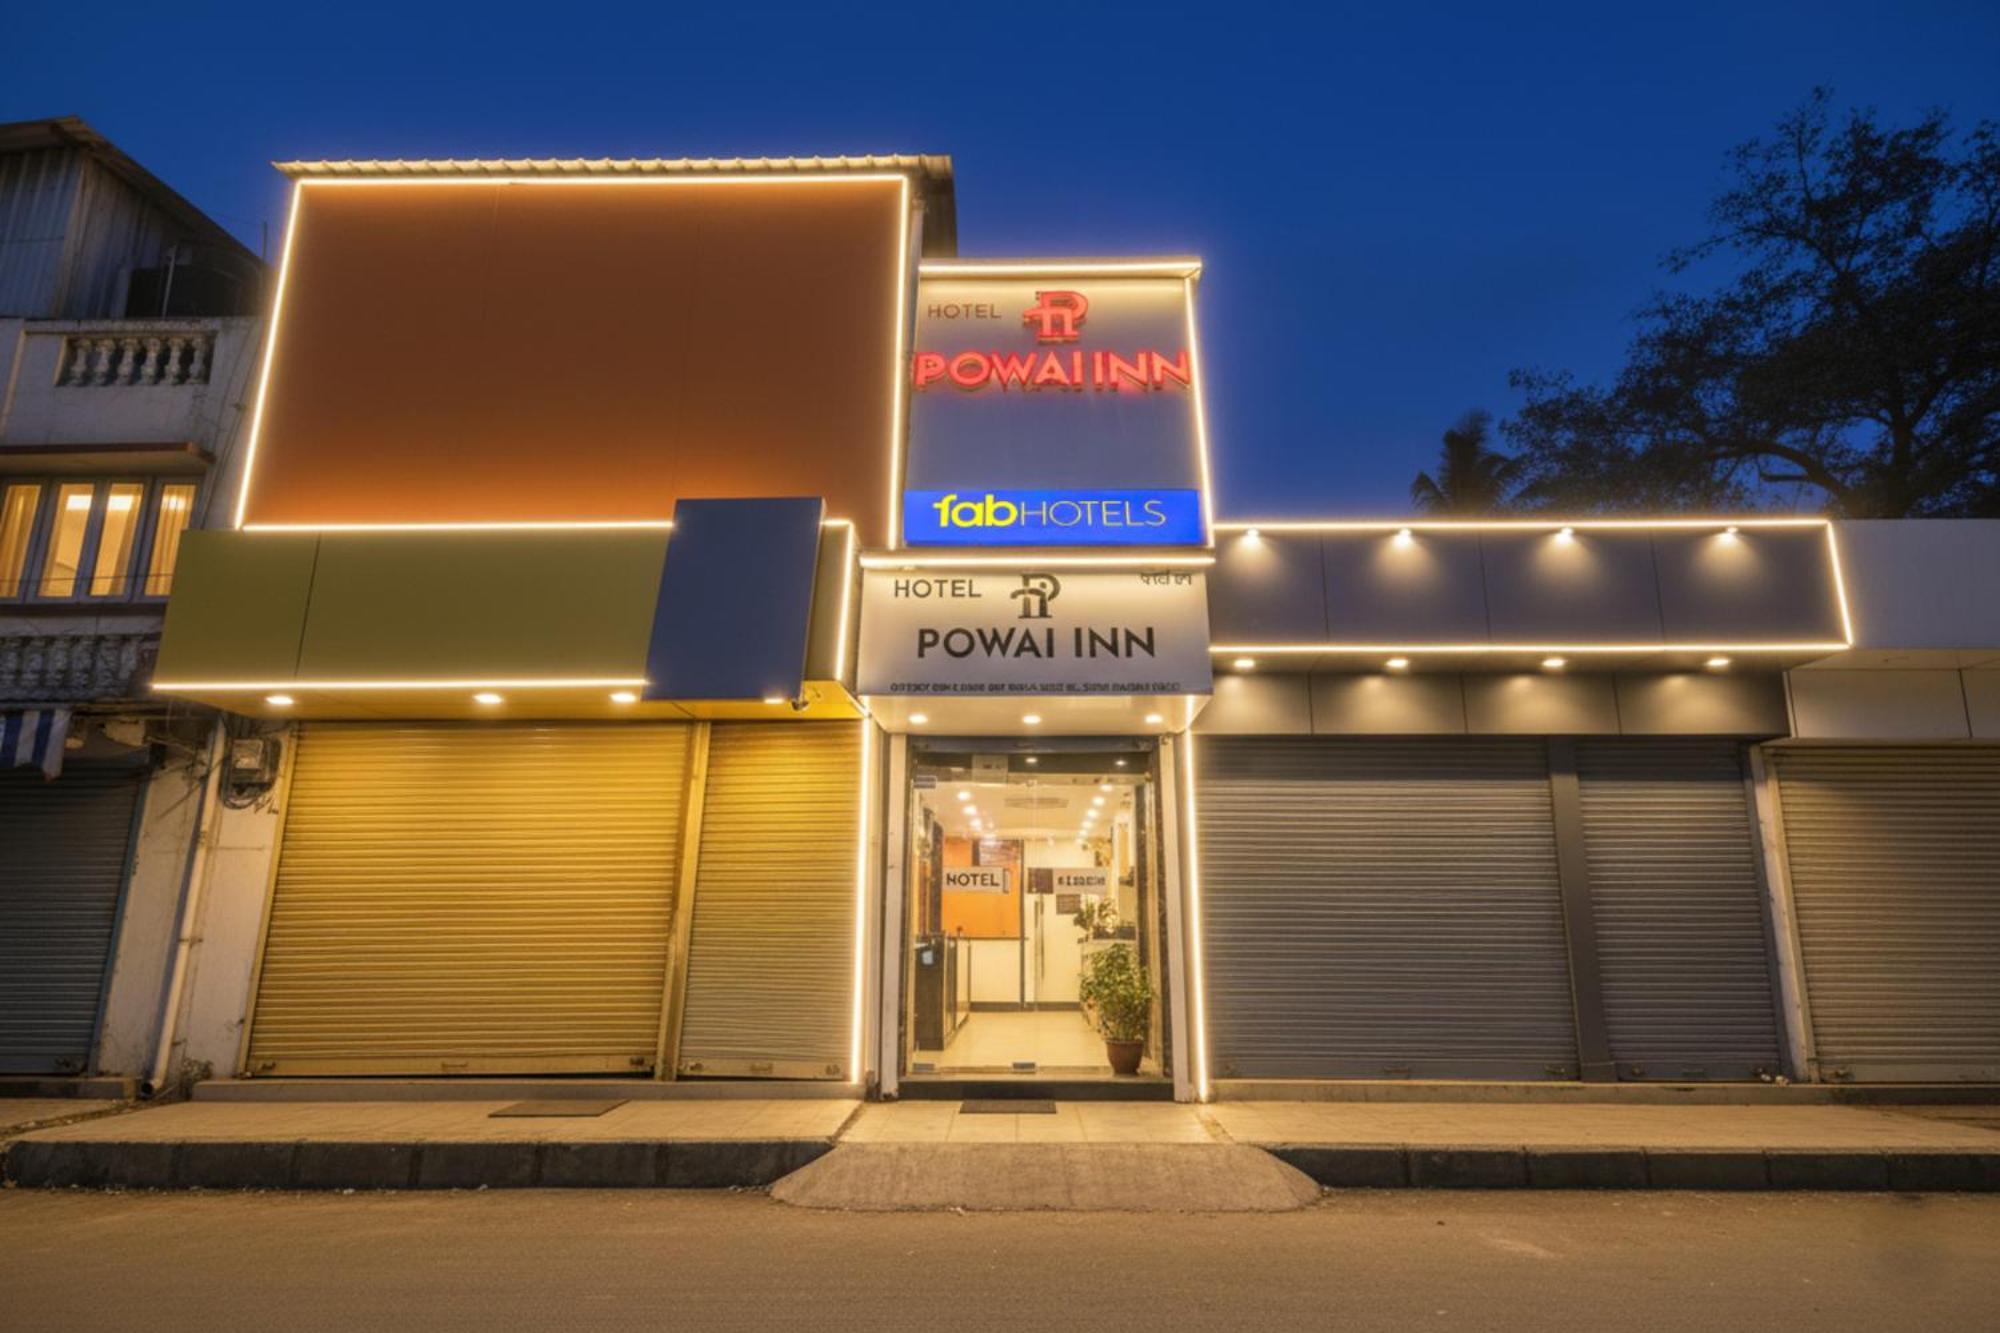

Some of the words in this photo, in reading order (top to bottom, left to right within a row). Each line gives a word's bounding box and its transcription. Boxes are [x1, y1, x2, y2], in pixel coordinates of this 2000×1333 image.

[927, 304, 1002, 319] HOTEL
[914, 351, 1083, 388] POWAI
[1094, 351, 1191, 390] INN
[894, 579, 982, 598] HOTEL
[917, 628, 1055, 659] POWAI
[1074, 627, 1155, 659] INN
